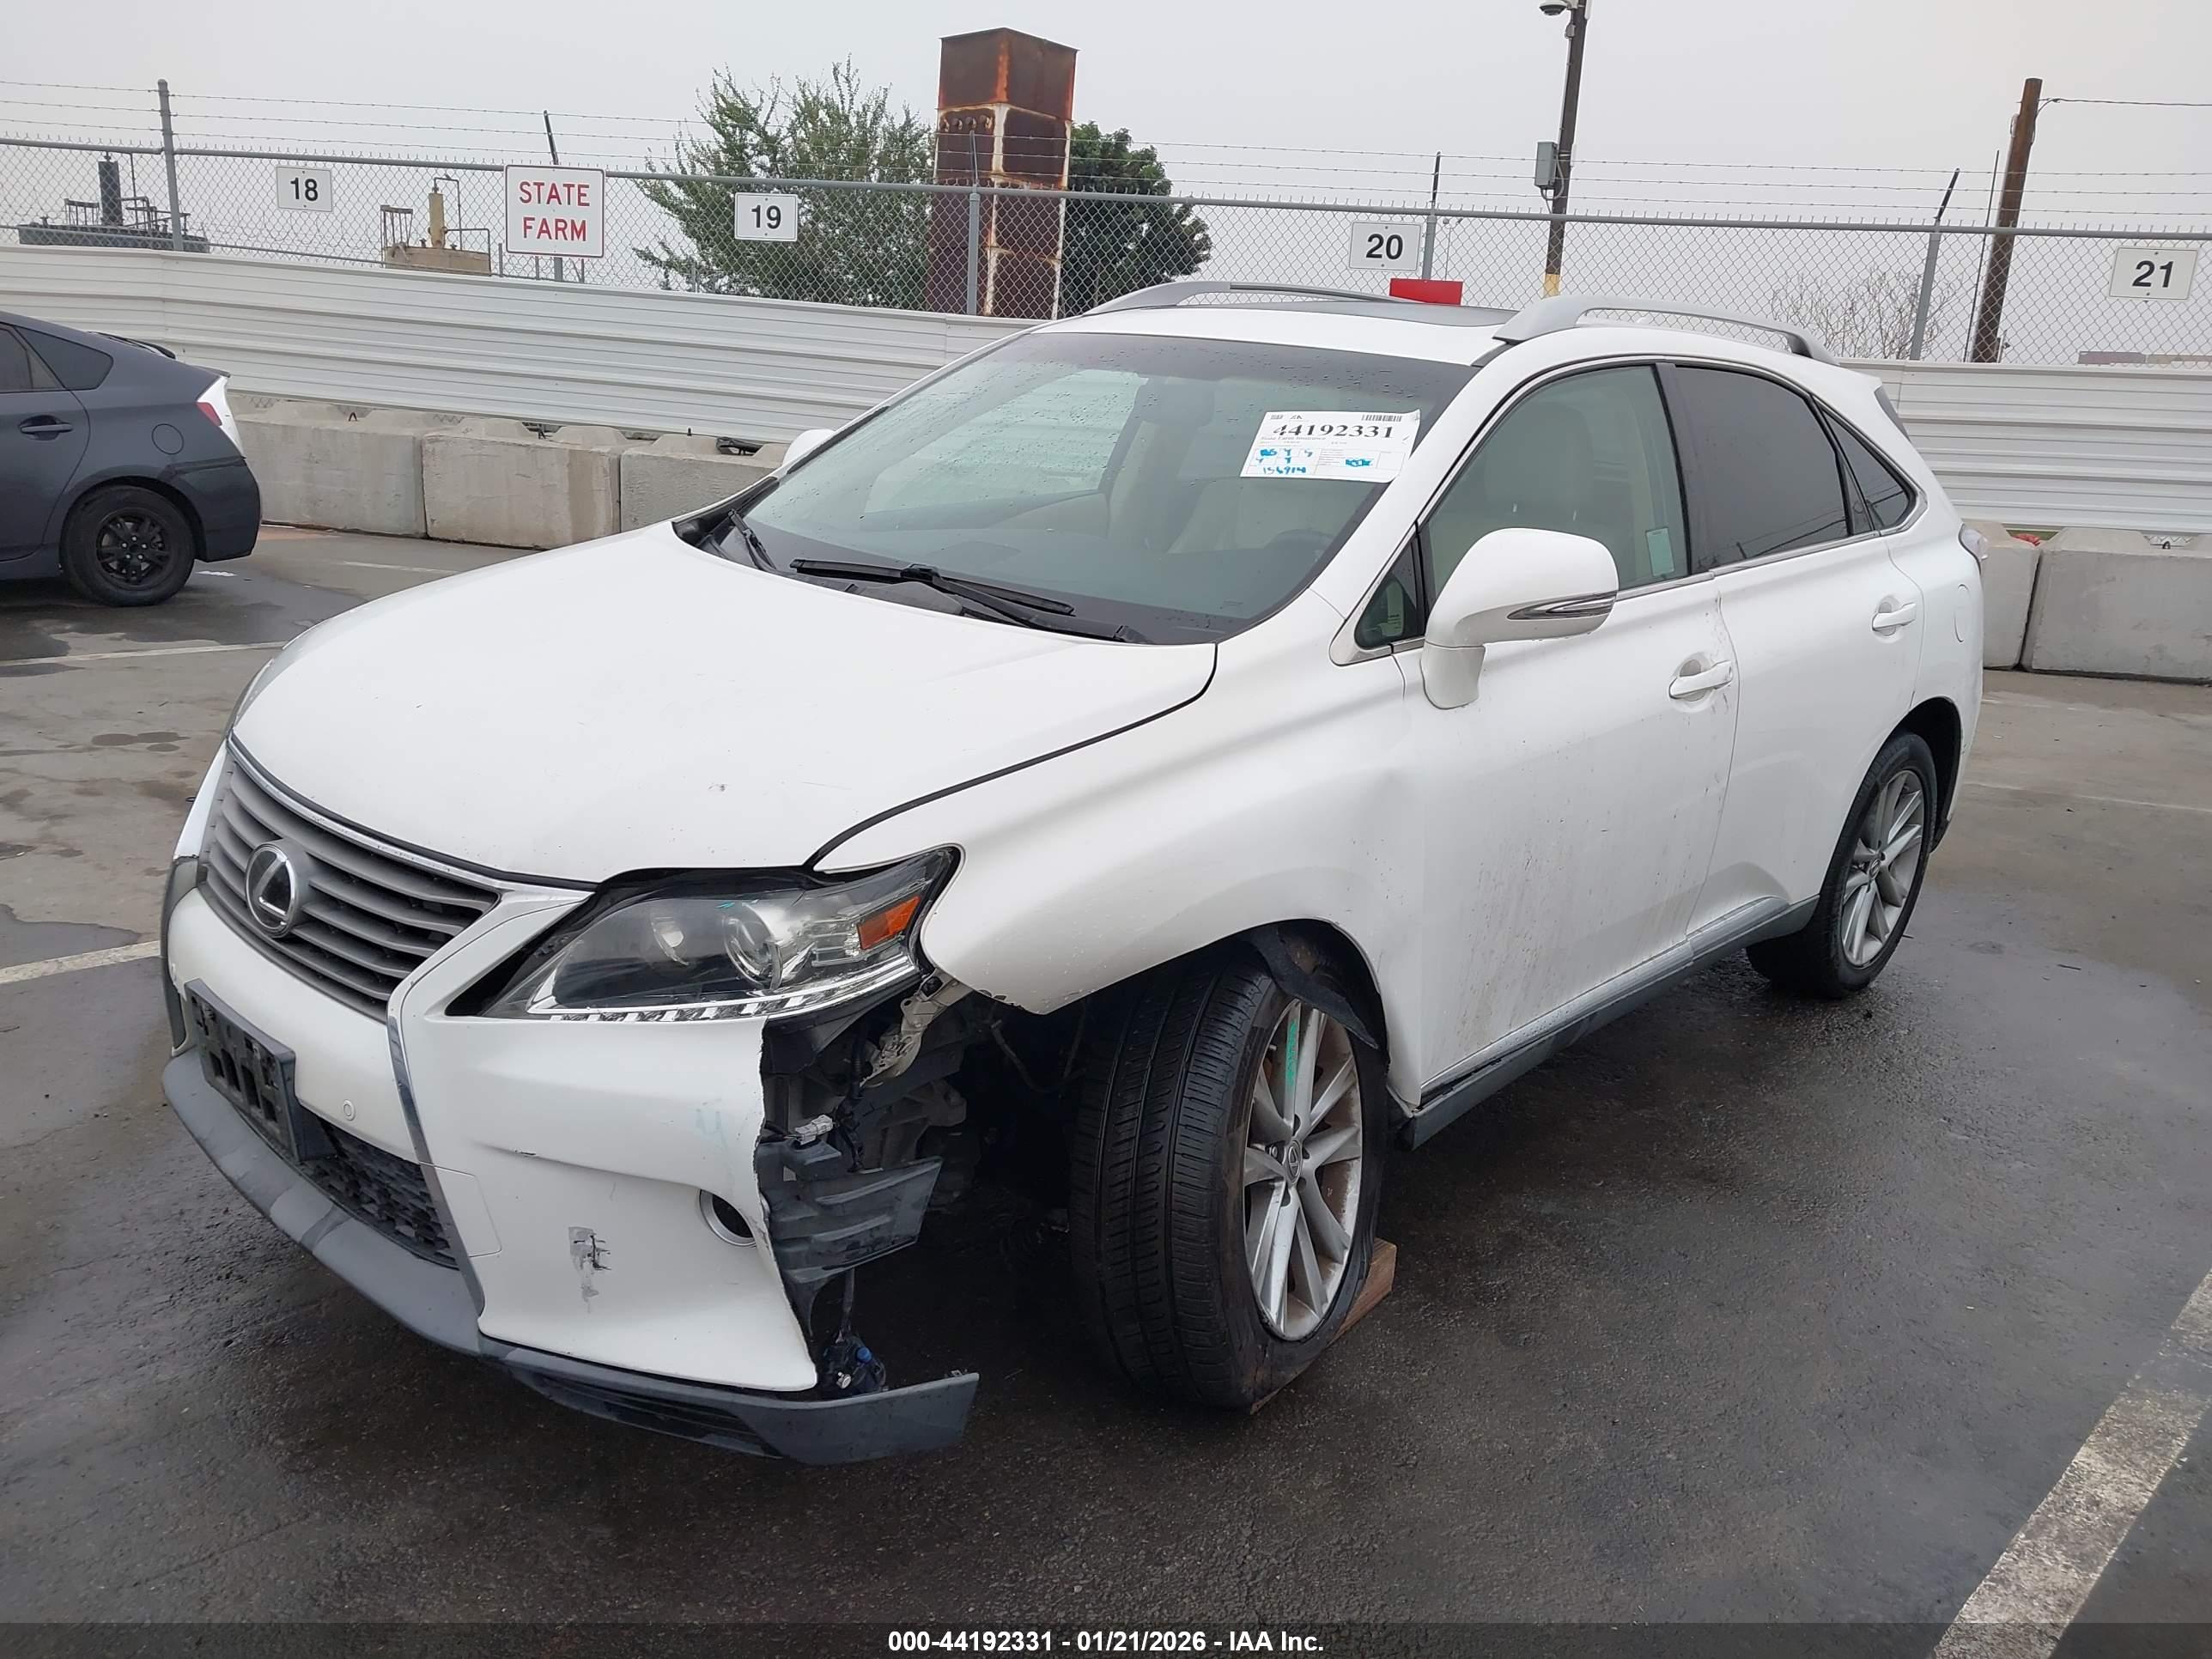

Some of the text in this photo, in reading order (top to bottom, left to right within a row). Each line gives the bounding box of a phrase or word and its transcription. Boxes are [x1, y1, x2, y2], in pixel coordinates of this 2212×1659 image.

[290, 178, 318, 201] 18
[520, 181, 590, 206] STATE
[523, 216, 586, 241] FARM
[751, 205, 781, 229] 19
[1366, 234, 1403, 259] 20
[2132, 260, 2173, 288] 21
[1273, 424, 1395, 438] 44192331
